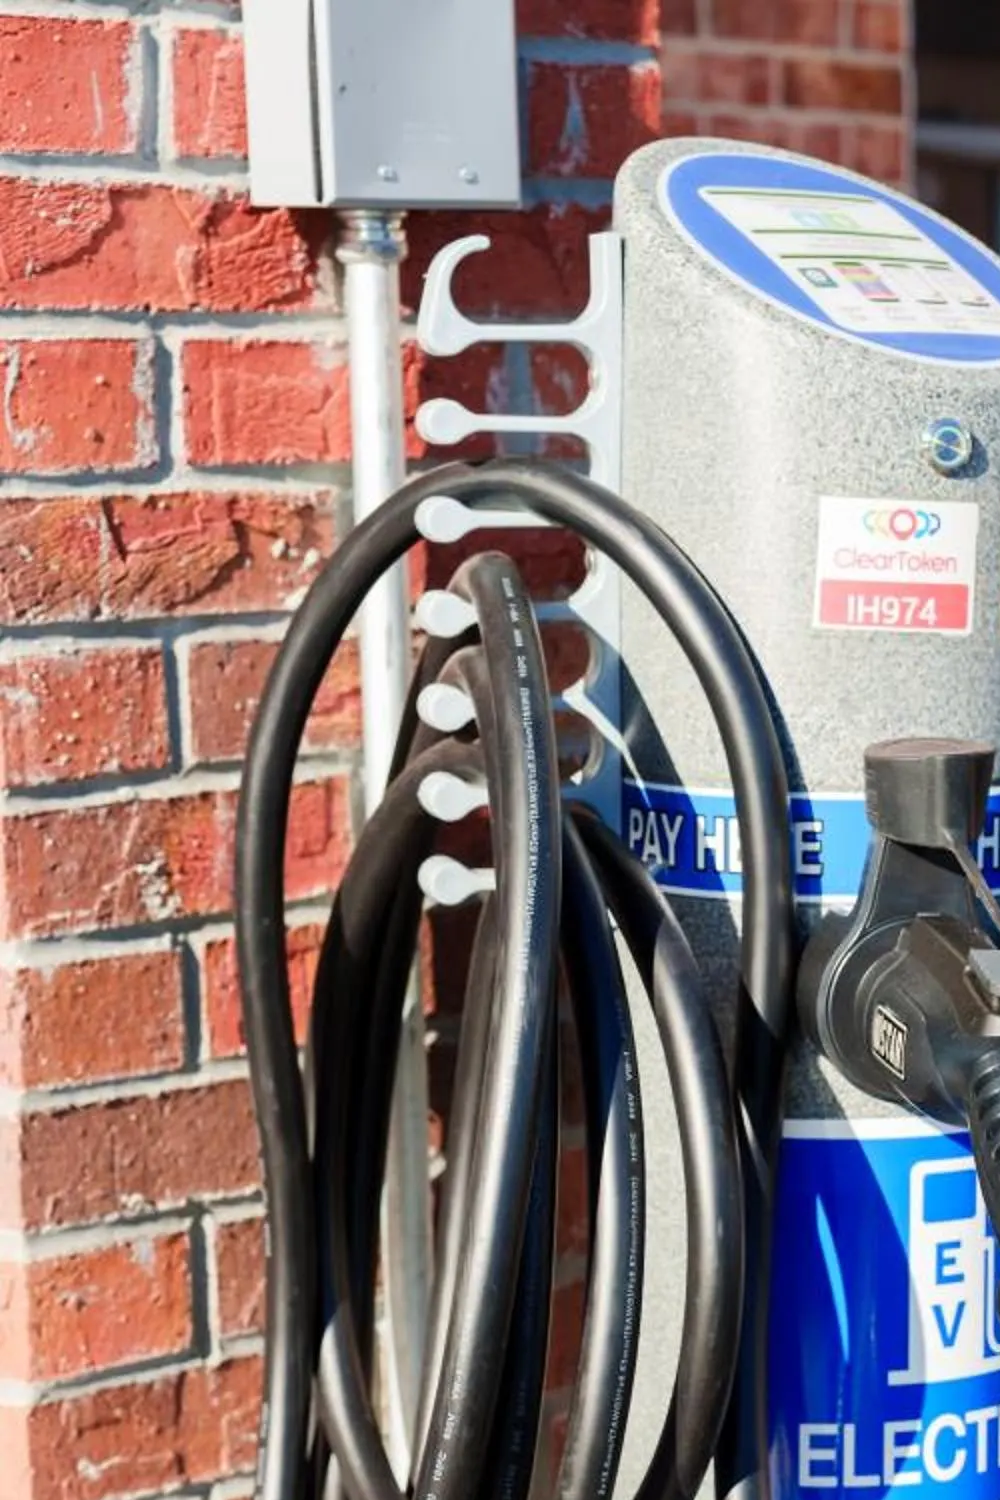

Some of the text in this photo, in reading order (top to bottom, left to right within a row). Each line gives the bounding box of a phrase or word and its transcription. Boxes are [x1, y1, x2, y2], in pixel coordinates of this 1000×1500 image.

[832, 546, 958, 574] ClearToken
[846, 593, 938, 627] IH974
[628, 807, 824, 875] PAY HEE
